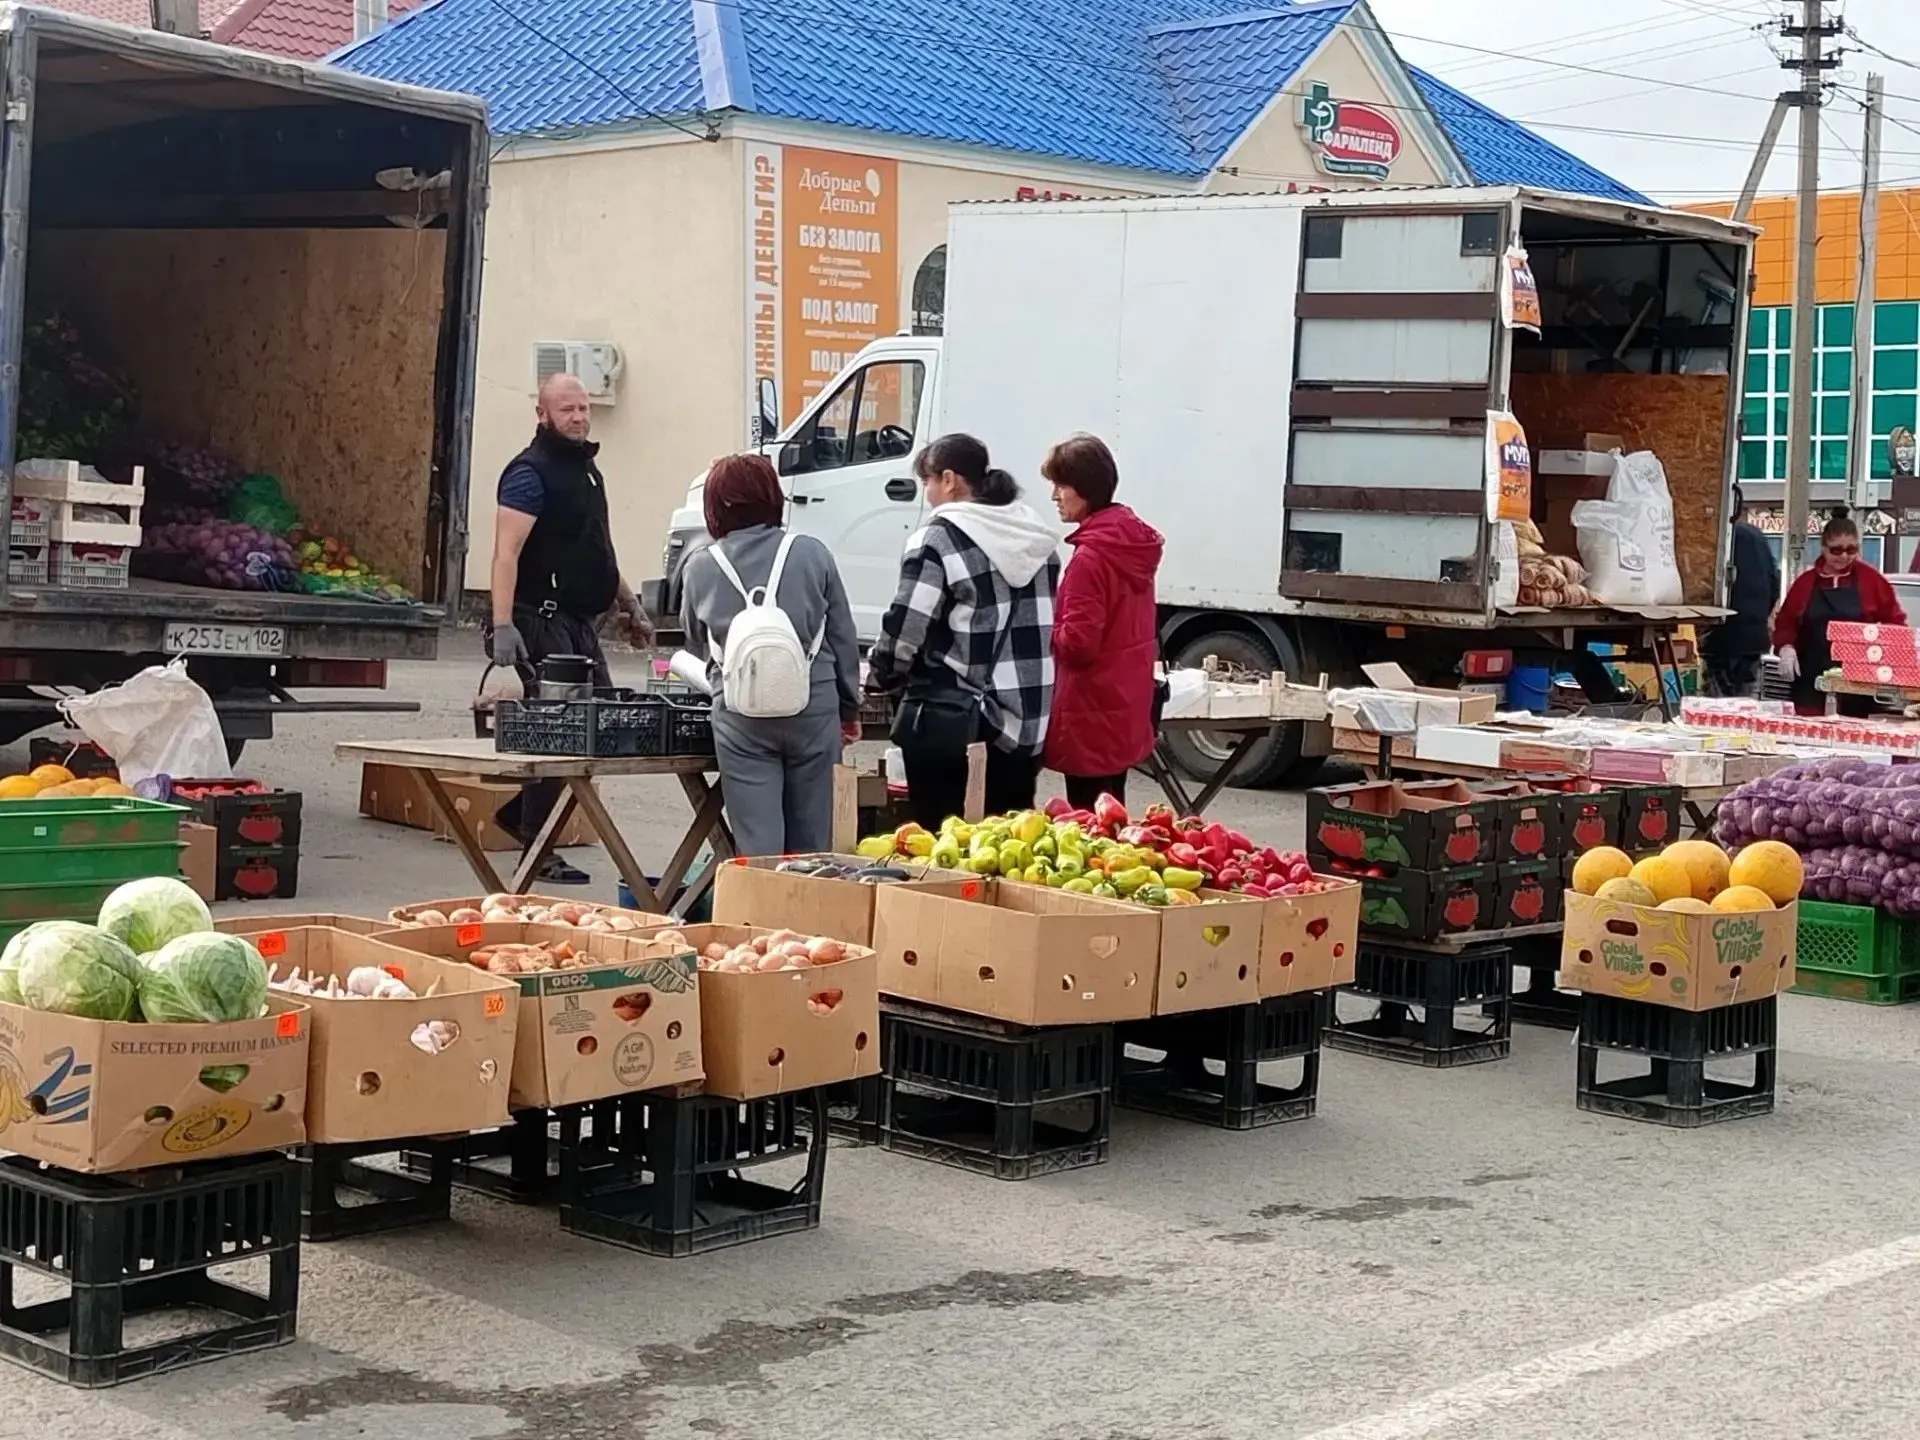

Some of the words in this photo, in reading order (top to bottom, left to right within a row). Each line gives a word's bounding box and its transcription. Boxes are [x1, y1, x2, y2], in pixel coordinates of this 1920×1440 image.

[1322, 130, 1393, 160] ФАРМЛЕНД
[799, 168, 862, 196] Добрые
[820, 191, 876, 215] Деньги
[799, 224, 826, 248] БЕЗ
[827, 227, 881, 253] ЗАЛОГА
[801, 298, 833, 325] ПОД
[834, 300, 879, 325] ЗАЛОГ
[755, 293, 775, 401] УЖНЫ
[253, 629, 281, 647] 102
[1712, 914, 1759, 941] Global
[1600, 939, 1638, 956] Global
[1716, 940, 1763, 965] Village
[1603, 954, 1645, 975] Village
[110, 1041, 187, 1055] SELECTED
[191, 1038, 257, 1055] PREMIUM
